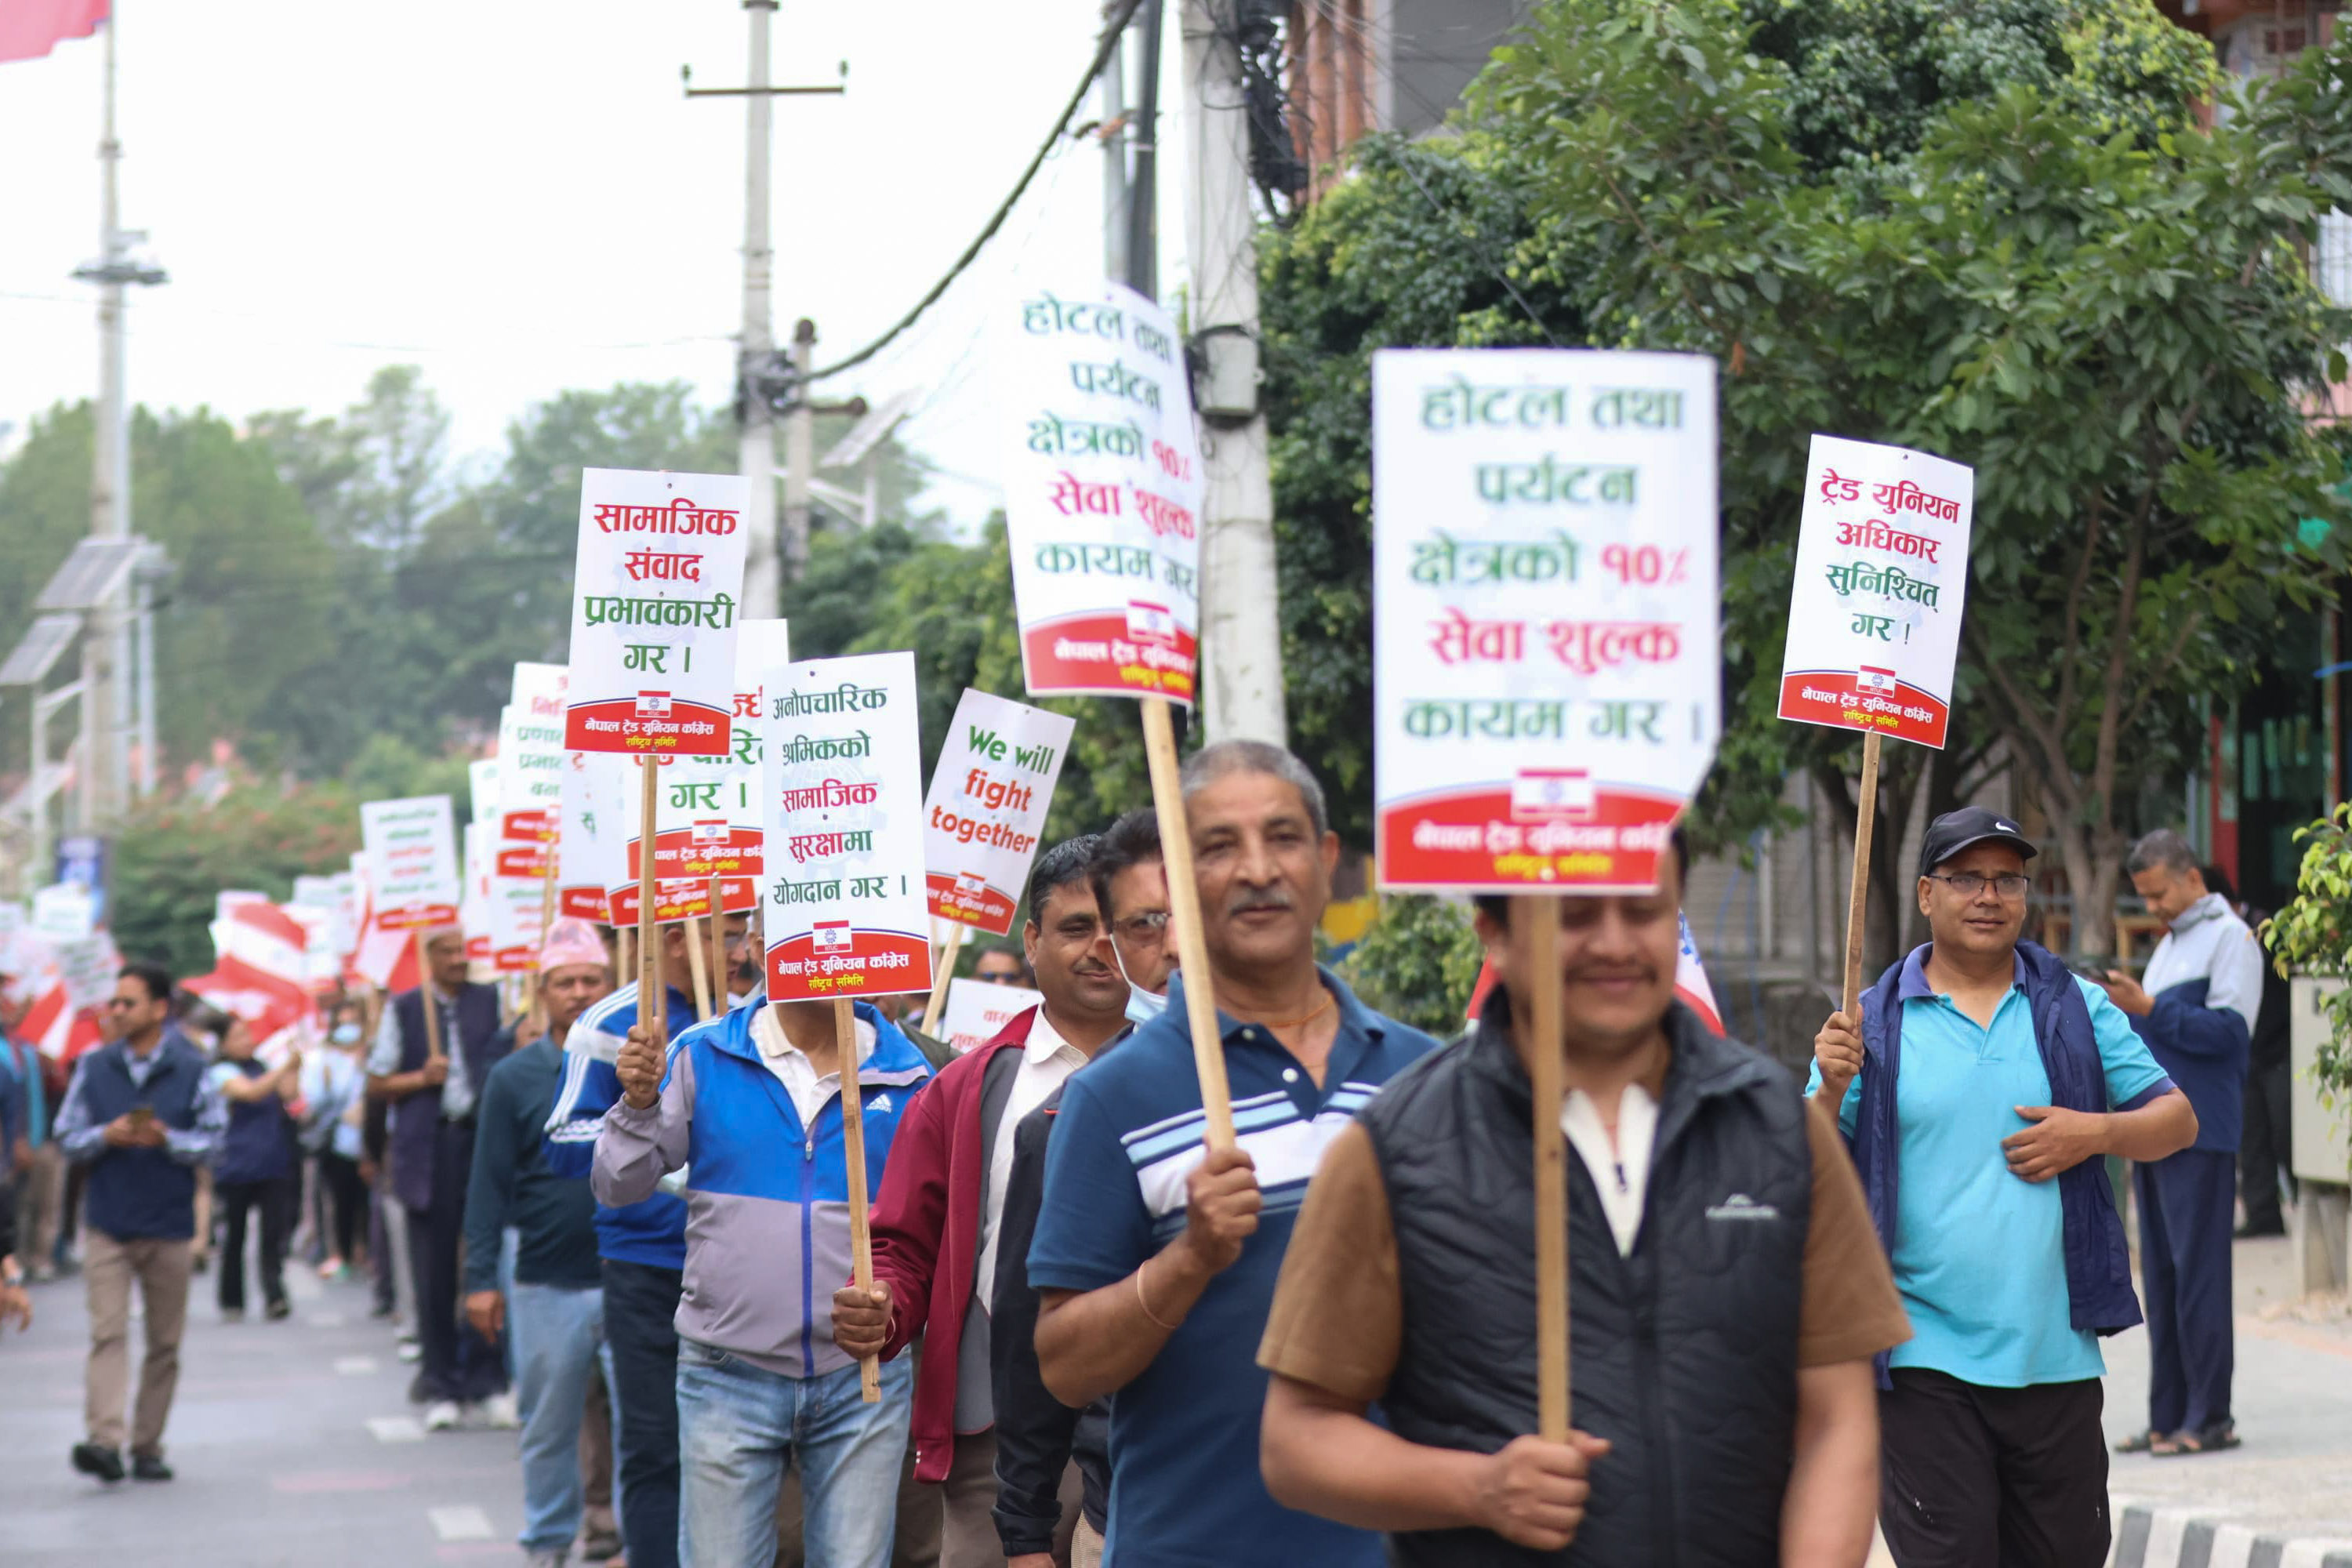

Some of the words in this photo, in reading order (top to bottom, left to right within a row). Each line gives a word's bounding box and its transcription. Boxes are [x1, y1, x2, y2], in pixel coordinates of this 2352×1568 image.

[1023, 291, 1124, 339] होटल
[1070, 358, 1161, 414] पर्यटन
[1418, 374, 1570, 432] होटल
[1589, 387, 1686, 430] तथा
[1027, 412, 1144, 460] क्षेत्रको
[1047, 470, 1121, 517] सेवा
[1475, 453, 1638, 506] पर्यटन
[1820, 468, 1864, 506] ट्रेड
[1872, 480, 1961, 523] युनियन
[593, 498, 739, 535] सामाजिक
[1409, 528, 1581, 586] क्षेत्रको
[1835, 519, 1941, 564] अधिकार
[625, 546, 703, 583] संवाद
[1034, 542, 1154, 581] कायम
[1825, 561, 1940, 613] सुनिश्चित्
[584, 593, 735, 629] प्रभावकारी
[1851, 613, 1895, 641] गर
[624, 644, 670, 673] गर
[1428, 606, 1524, 665] सेवा
[1547, 622, 1682, 675] शुल्क
[773, 683, 887, 720] अनौपचारिक
[1802, 686, 1837, 703] नेपाल
[1840, 691, 1859, 708] ट्रेड
[1862, 697, 1902, 716] युनियन
[584, 717, 620, 732] नेपाल
[622, 719, 641, 735] ट्रेड
[642, 719, 680, 736] युनियन
[1401, 699, 1570, 741] कायम
[1588, 700, 1666, 744] गर
[782, 730, 871, 766] श्रमिकको
[969, 725, 1007, 761] We
[1015, 745, 1054, 775] will
[670, 782, 722, 810] गर
[782, 778, 877, 812] सामाजिक
[964, 768, 1032, 811] fight
[789, 830, 873, 863] सुरक्षामा
[931, 805, 1036, 853] together
[773, 877, 841, 905] योगदान
[849, 876, 888, 898] गर
[779, 960, 802, 975] नेपाल
[804, 958, 818, 976] ट्रेड
[821, 955, 866, 975] युनियन
[836, 973, 864, 989] समिति
